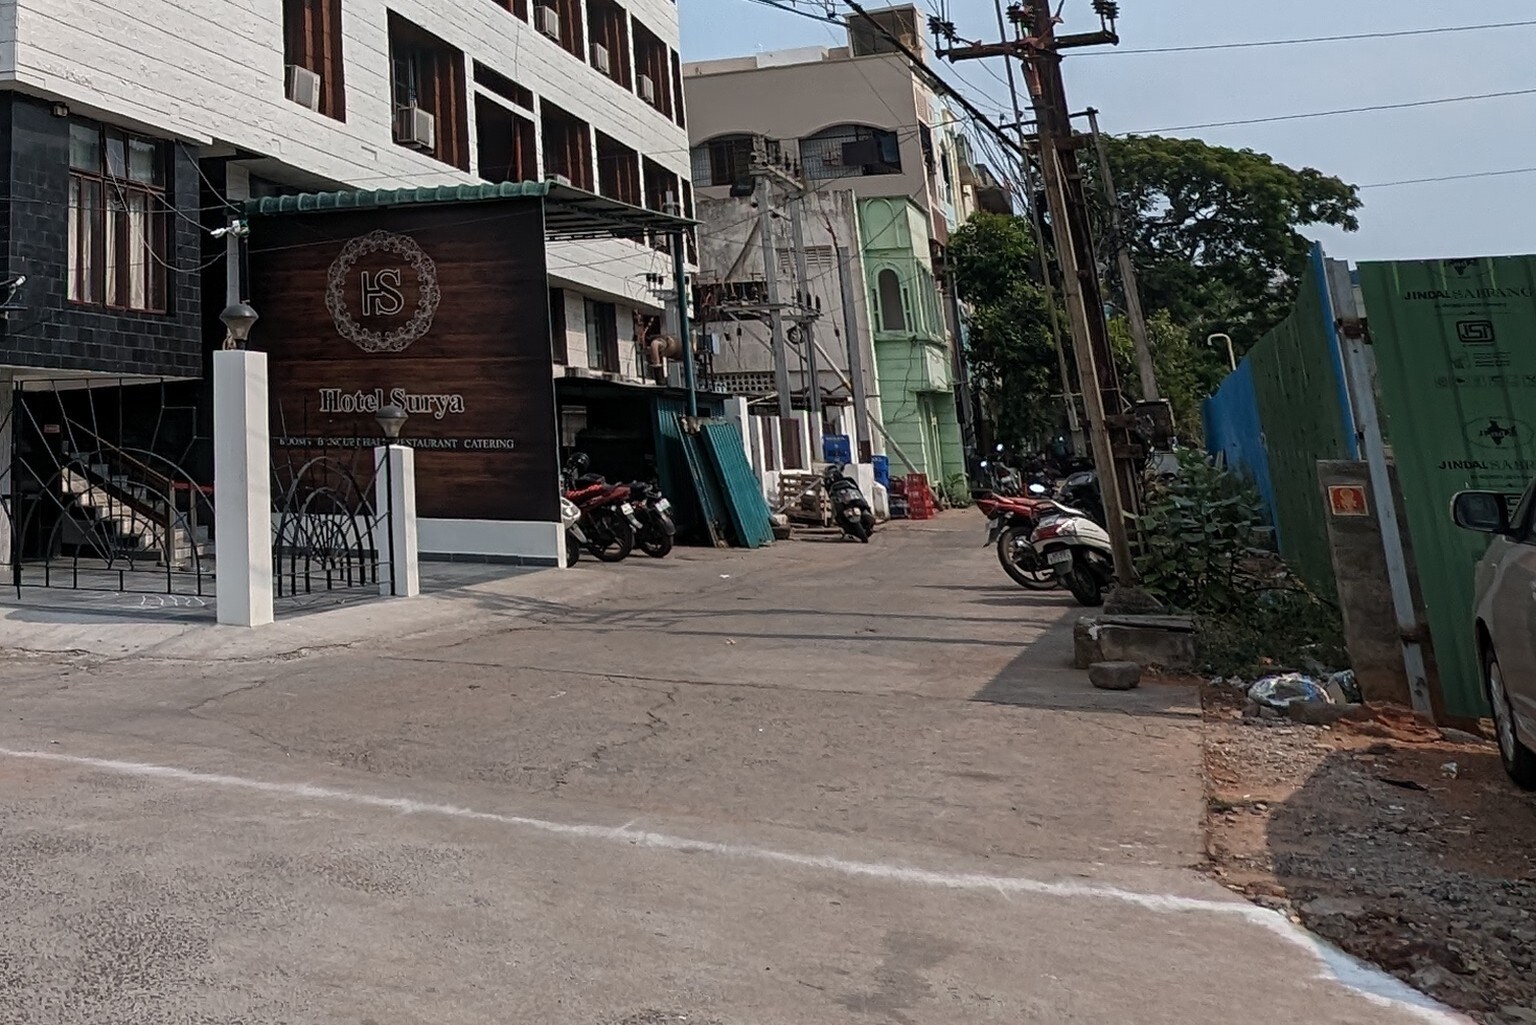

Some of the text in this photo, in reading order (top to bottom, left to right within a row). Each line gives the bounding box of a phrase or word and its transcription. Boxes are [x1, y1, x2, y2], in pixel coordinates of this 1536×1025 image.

[1404, 290, 1451, 300] JINDAL
[319, 387, 465, 420] Hotel Surya
[464, 438, 514, 449] CATERING
[1439, 460, 1488, 470] JINDAL
